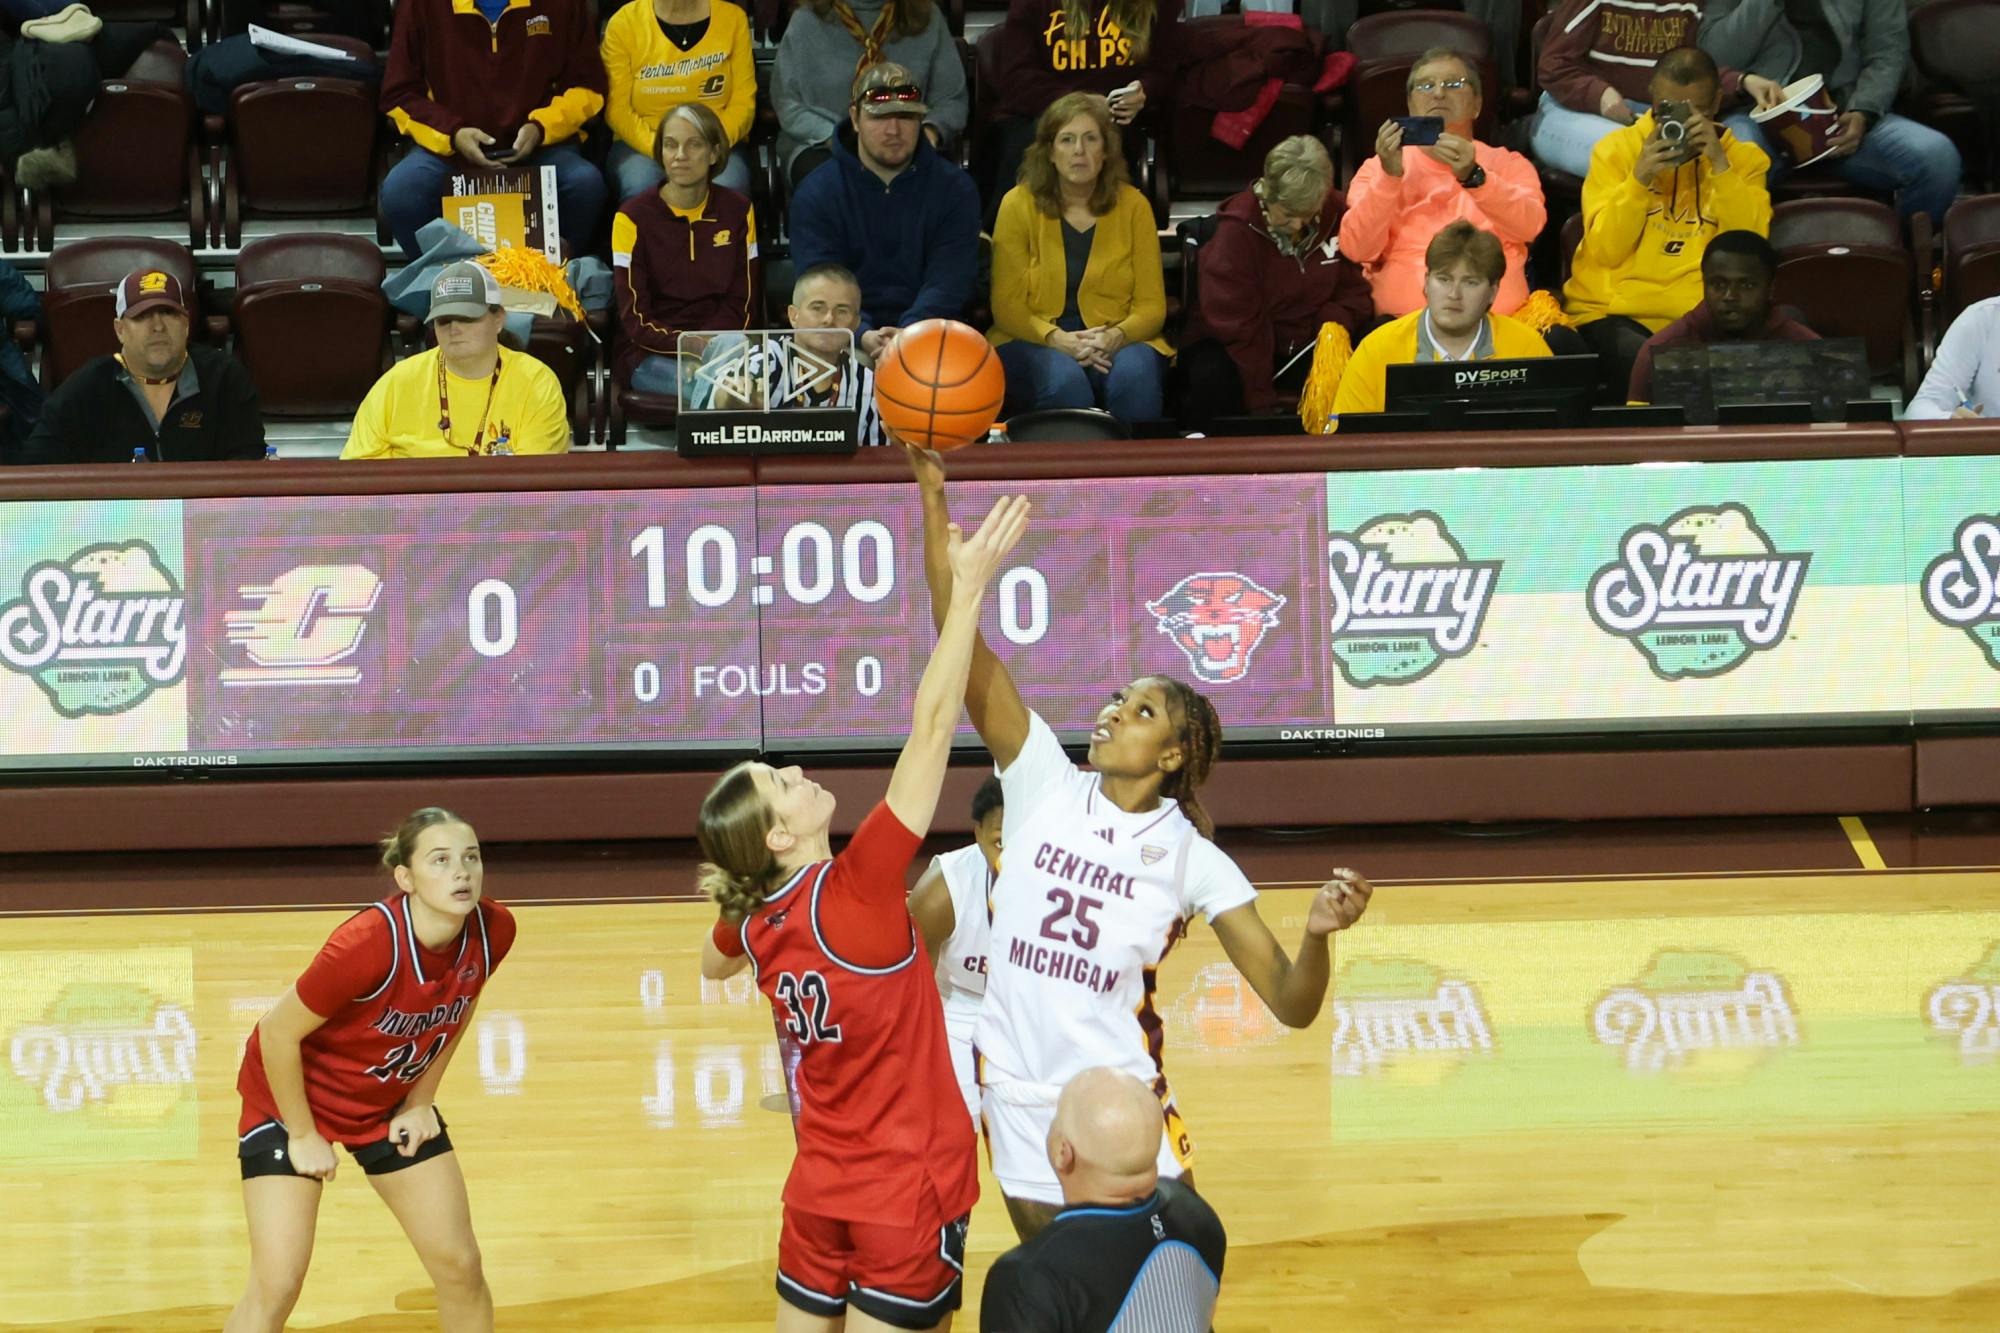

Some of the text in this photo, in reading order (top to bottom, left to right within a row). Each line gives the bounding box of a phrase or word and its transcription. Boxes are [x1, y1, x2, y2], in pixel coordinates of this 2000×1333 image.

[640, 51, 725, 80] Central Michigan
[631, 521, 895, 608] 10:00
[1594, 530, 1801, 644] Starry
[0, 567, 186, 681] Starry
[468, 578, 519, 657] 0
[999, 566, 1049, 645] 0
[634, 656, 882, 701] 0 FOULS 0
[133, 755, 238, 767] DAKTRONICS
[1281, 728, 1385, 740] DAKTRONICS
[1034, 842, 1136, 900] CENTRAL
[1039, 887, 1104, 951] 25
[1009, 936, 1120, 993] MICHIGAN
[775, 970, 842, 1045] 32
[363, 1033, 447, 1084] 24
